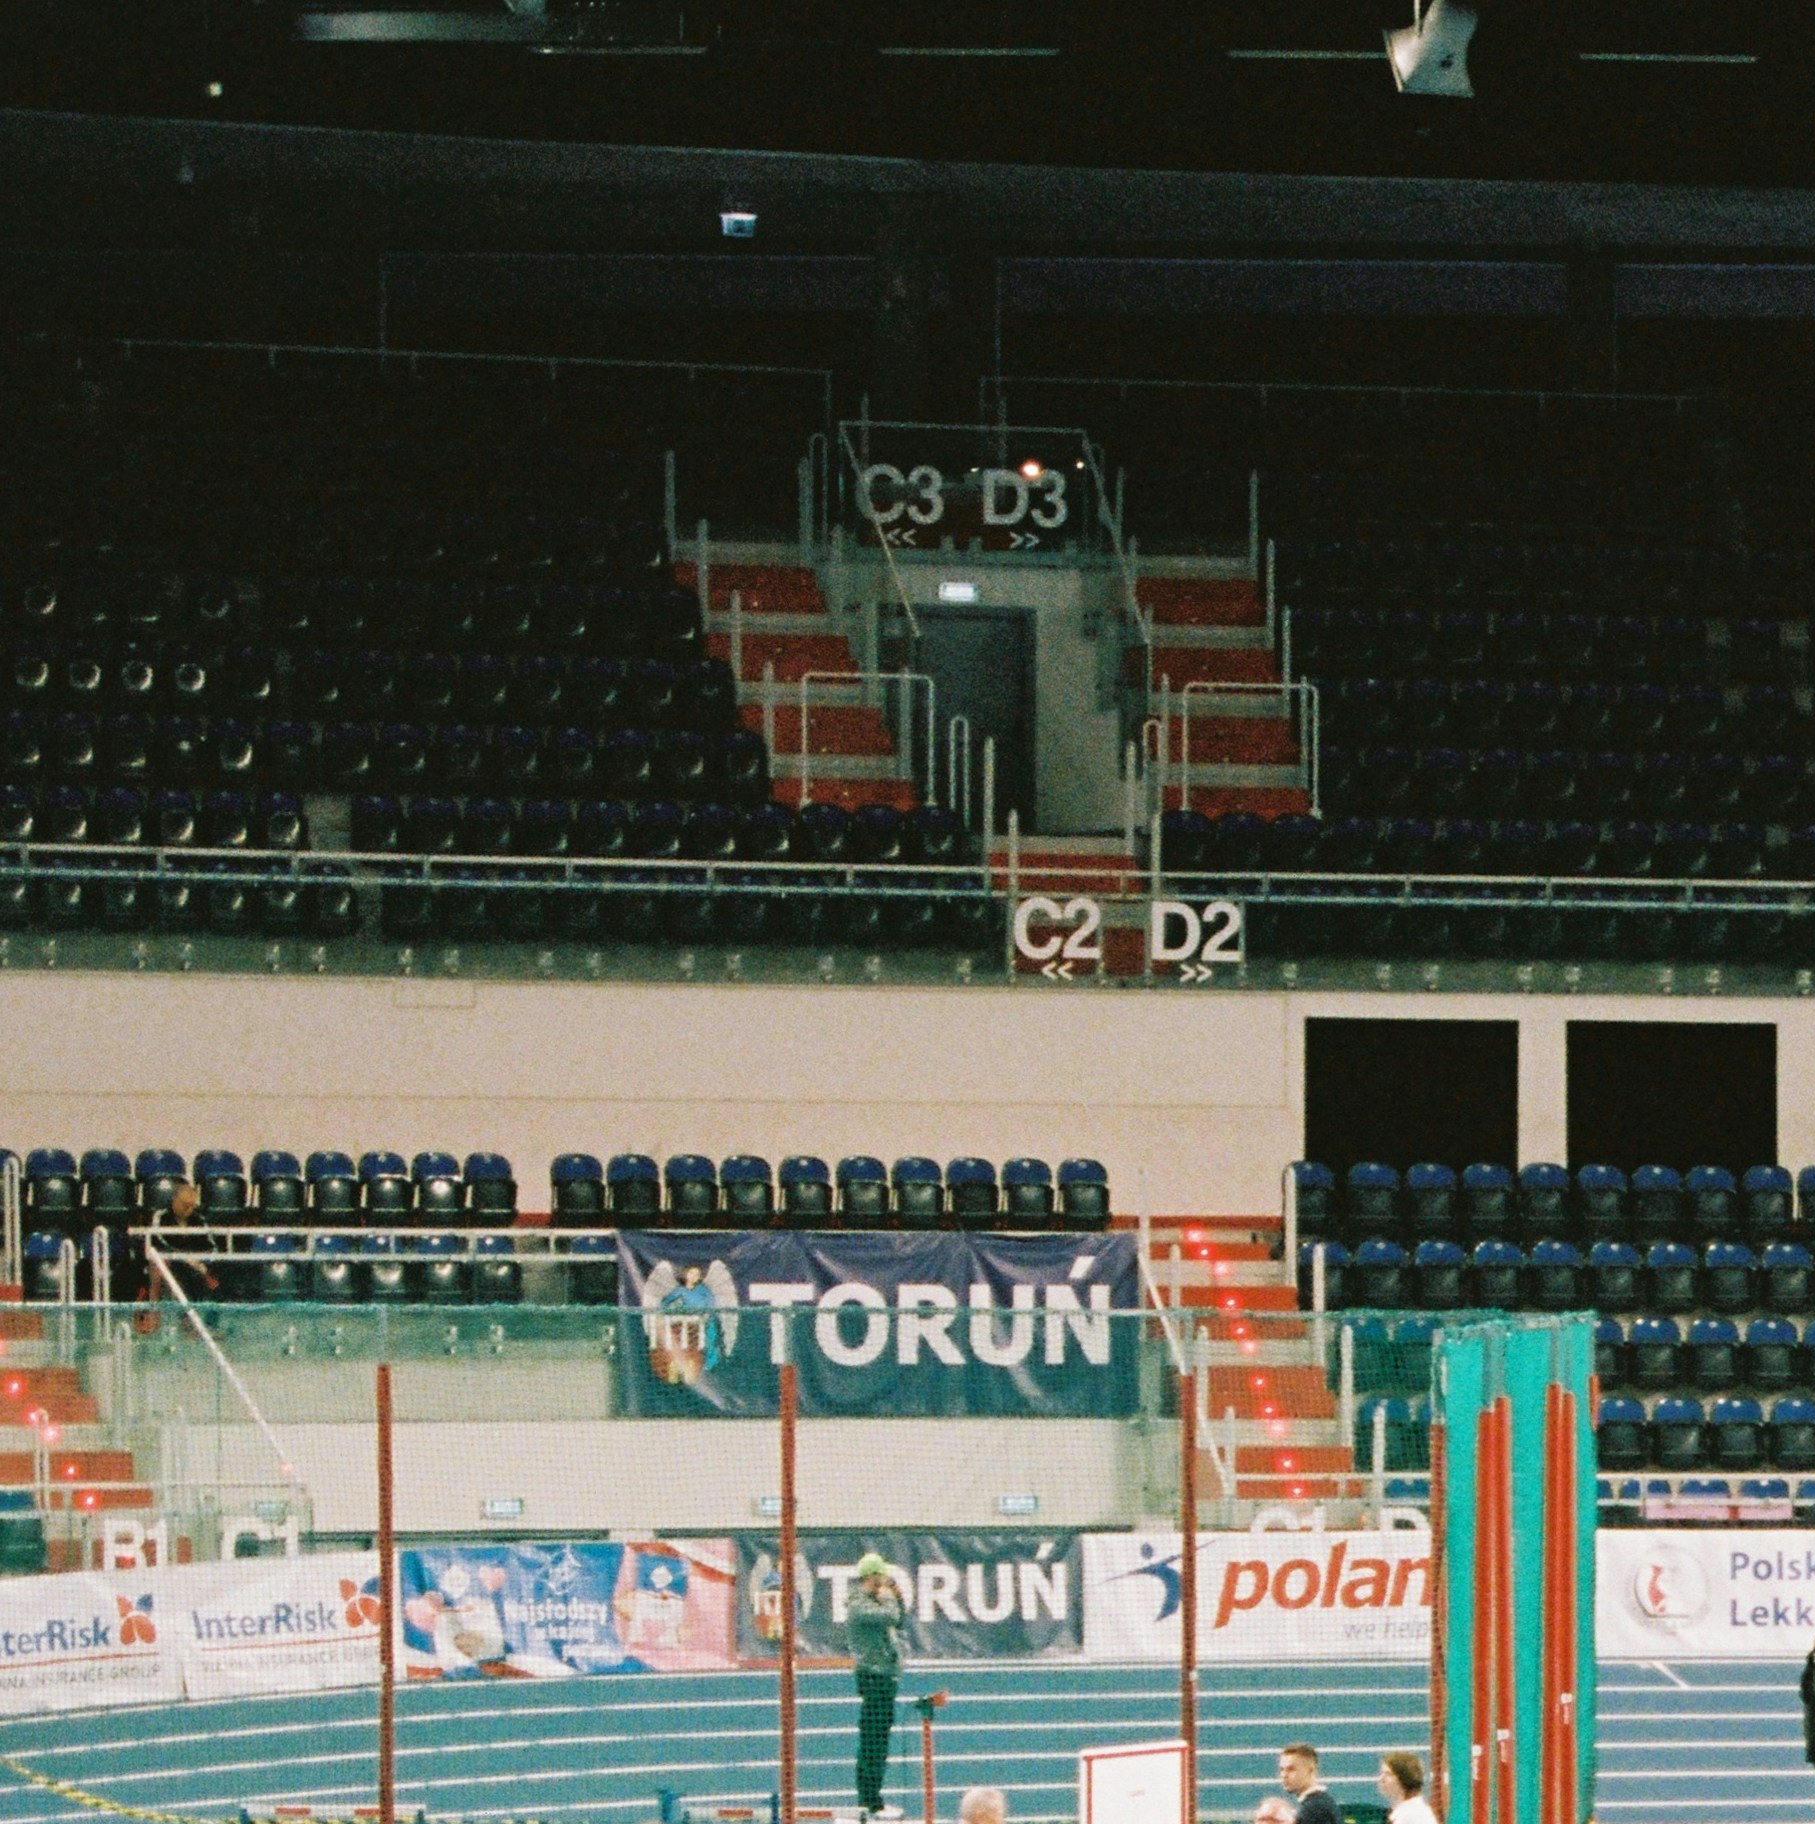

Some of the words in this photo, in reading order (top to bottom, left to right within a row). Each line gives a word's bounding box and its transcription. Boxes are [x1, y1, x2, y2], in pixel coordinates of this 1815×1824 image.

[861, 464, 945, 524] C3
[982, 466, 1069, 528] D3
[1012, 898, 1101, 961] C2
[1152, 901, 1244, 963] D2
[749, 1257, 1111, 1367] TORUŃ
[1213, 1539, 1433, 1630] polan
[192, 1601, 337, 1642] InterRisk
